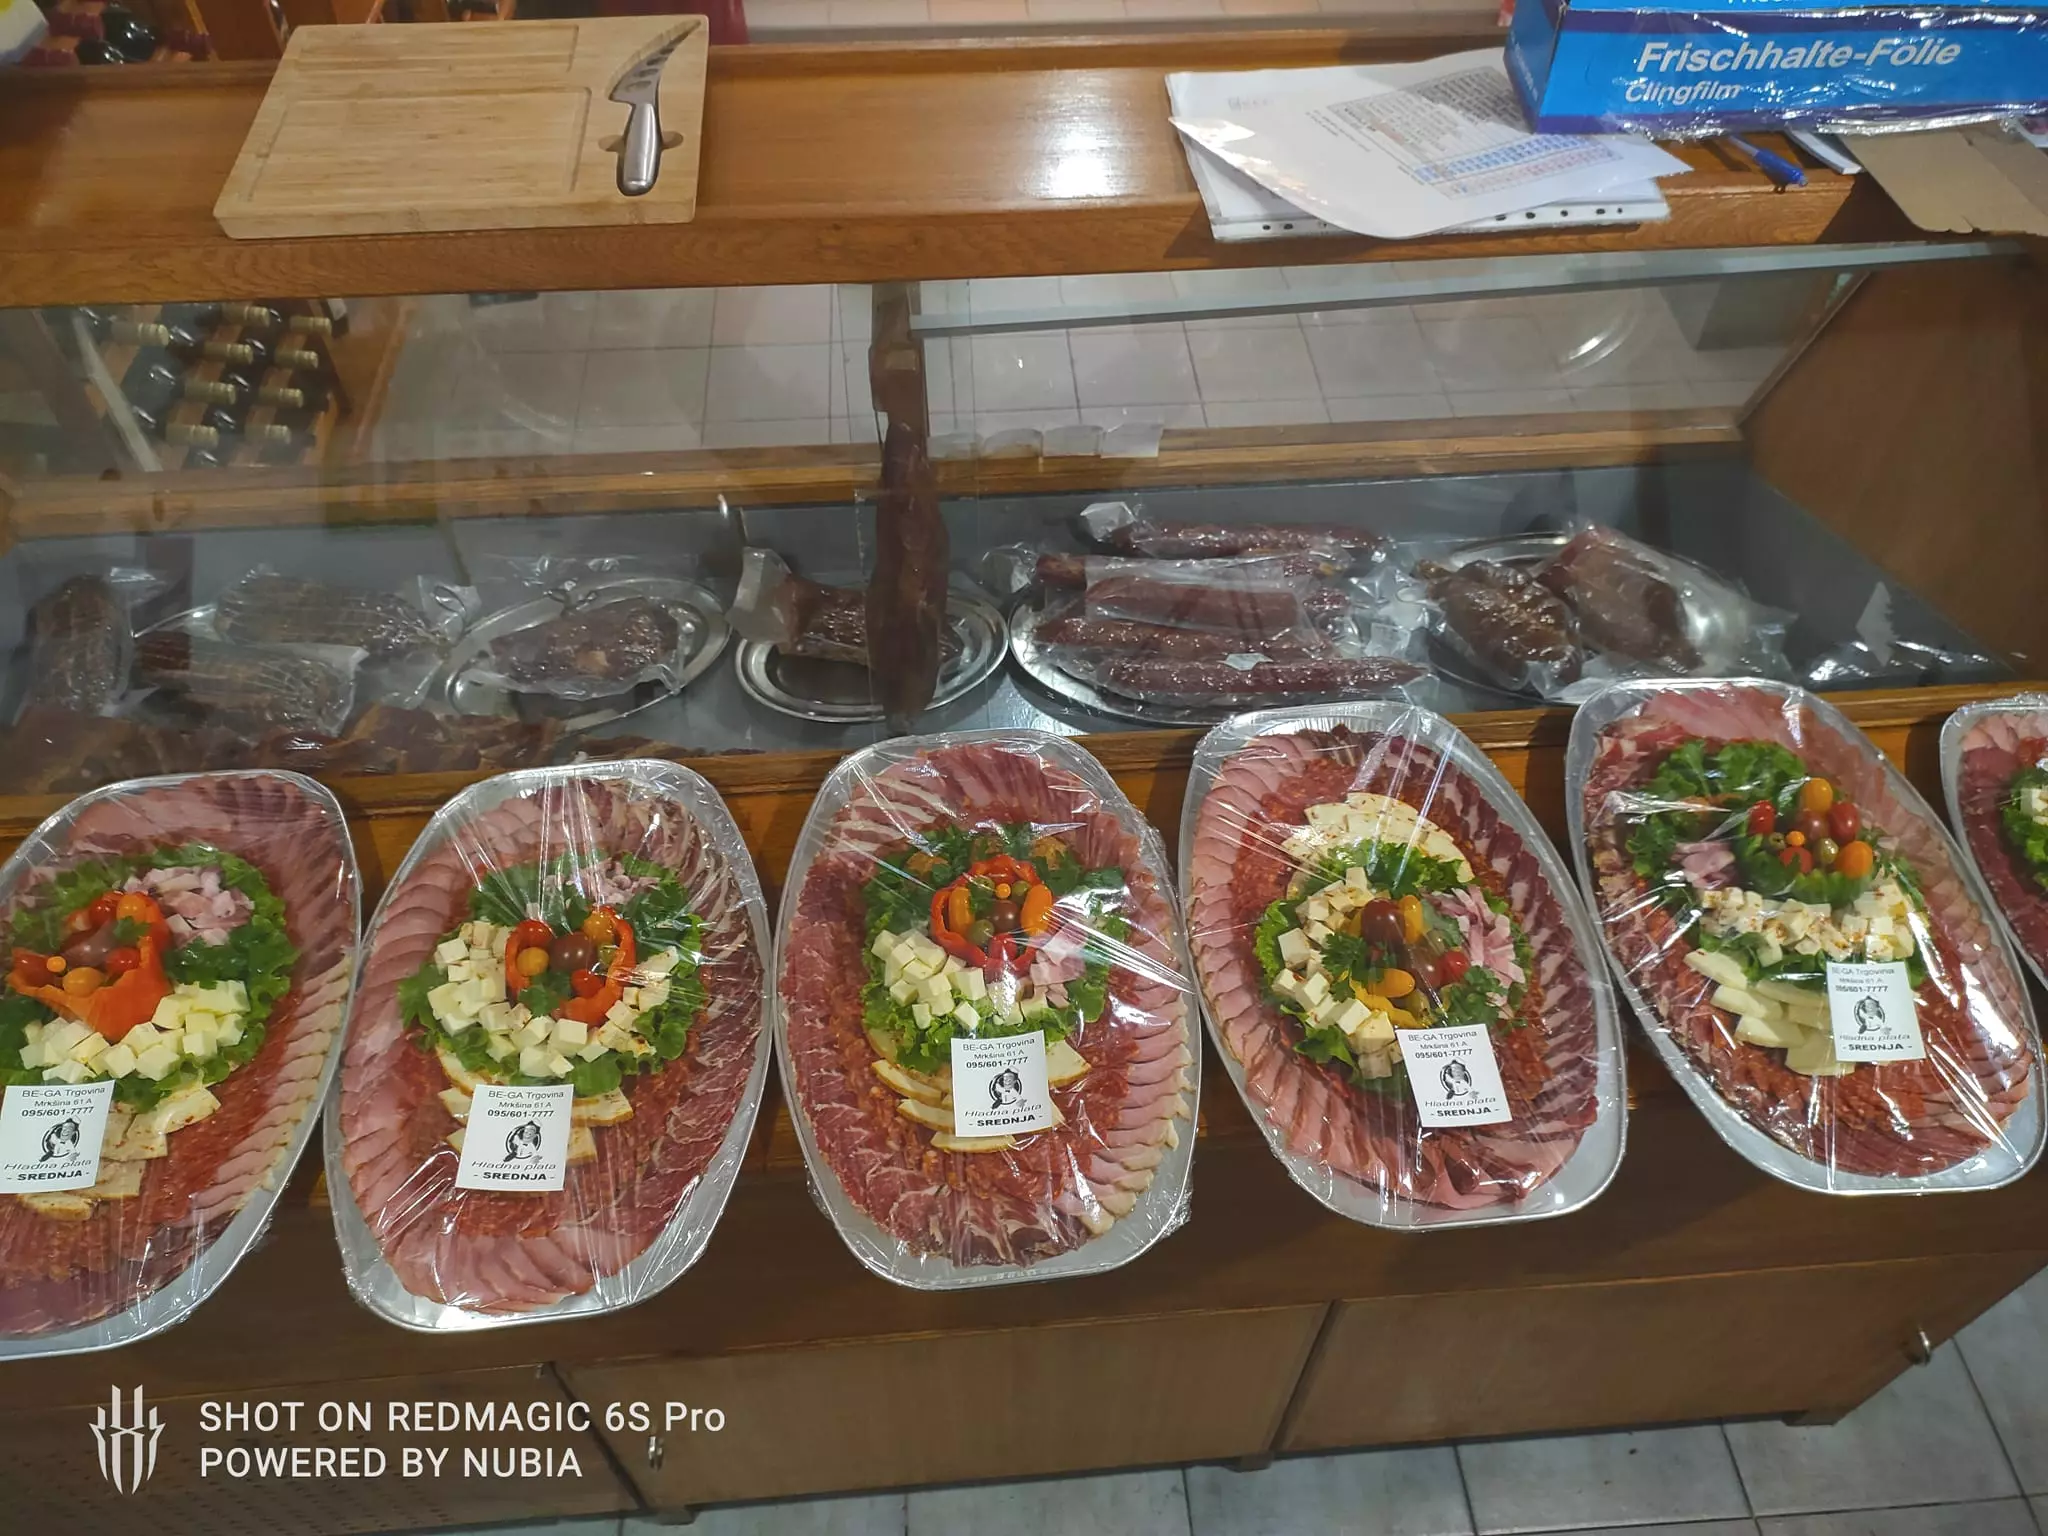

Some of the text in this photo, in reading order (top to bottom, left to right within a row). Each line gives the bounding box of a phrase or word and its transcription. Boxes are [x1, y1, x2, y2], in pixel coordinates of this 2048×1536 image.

[1636, 35, 1962, 74] Frischhalte-Folie
[1624, 80, 1742, 107] Clingfilm
[1407, 1030, 1477, 1042] BE-GA Trgovina
[963, 1038, 1035, 1051] BE-GA Trgovina
[1848, 1043, 1904, 1051] SREDNJA
[1415, 1048, 1473, 1059] 095/601-7777
[966, 1056, 1028, 1069] 095/601-7777
[22, 1087, 106, 1098] BE-GA Trgovina
[488, 1090, 564, 1100] BE-GA Trgovina
[1466, 1097, 1496, 1107] plata
[21, 1106, 94, 1117] 095/601-7777
[487, 1109, 555, 1118] 095/601-7777
[965, 1104, 1042, 1117] Hladna plata
[1436, 1106, 1492, 1117] SREDNJA
[977, 1114, 1036, 1127] SREDNJA
[4, 1159, 92, 1170] Hladna plata
[471, 1160, 557, 1171] Hladna plata
[17, 1170, 82, 1181] SREDNJA
[482, 1171, 547, 1181] SREDNJA
